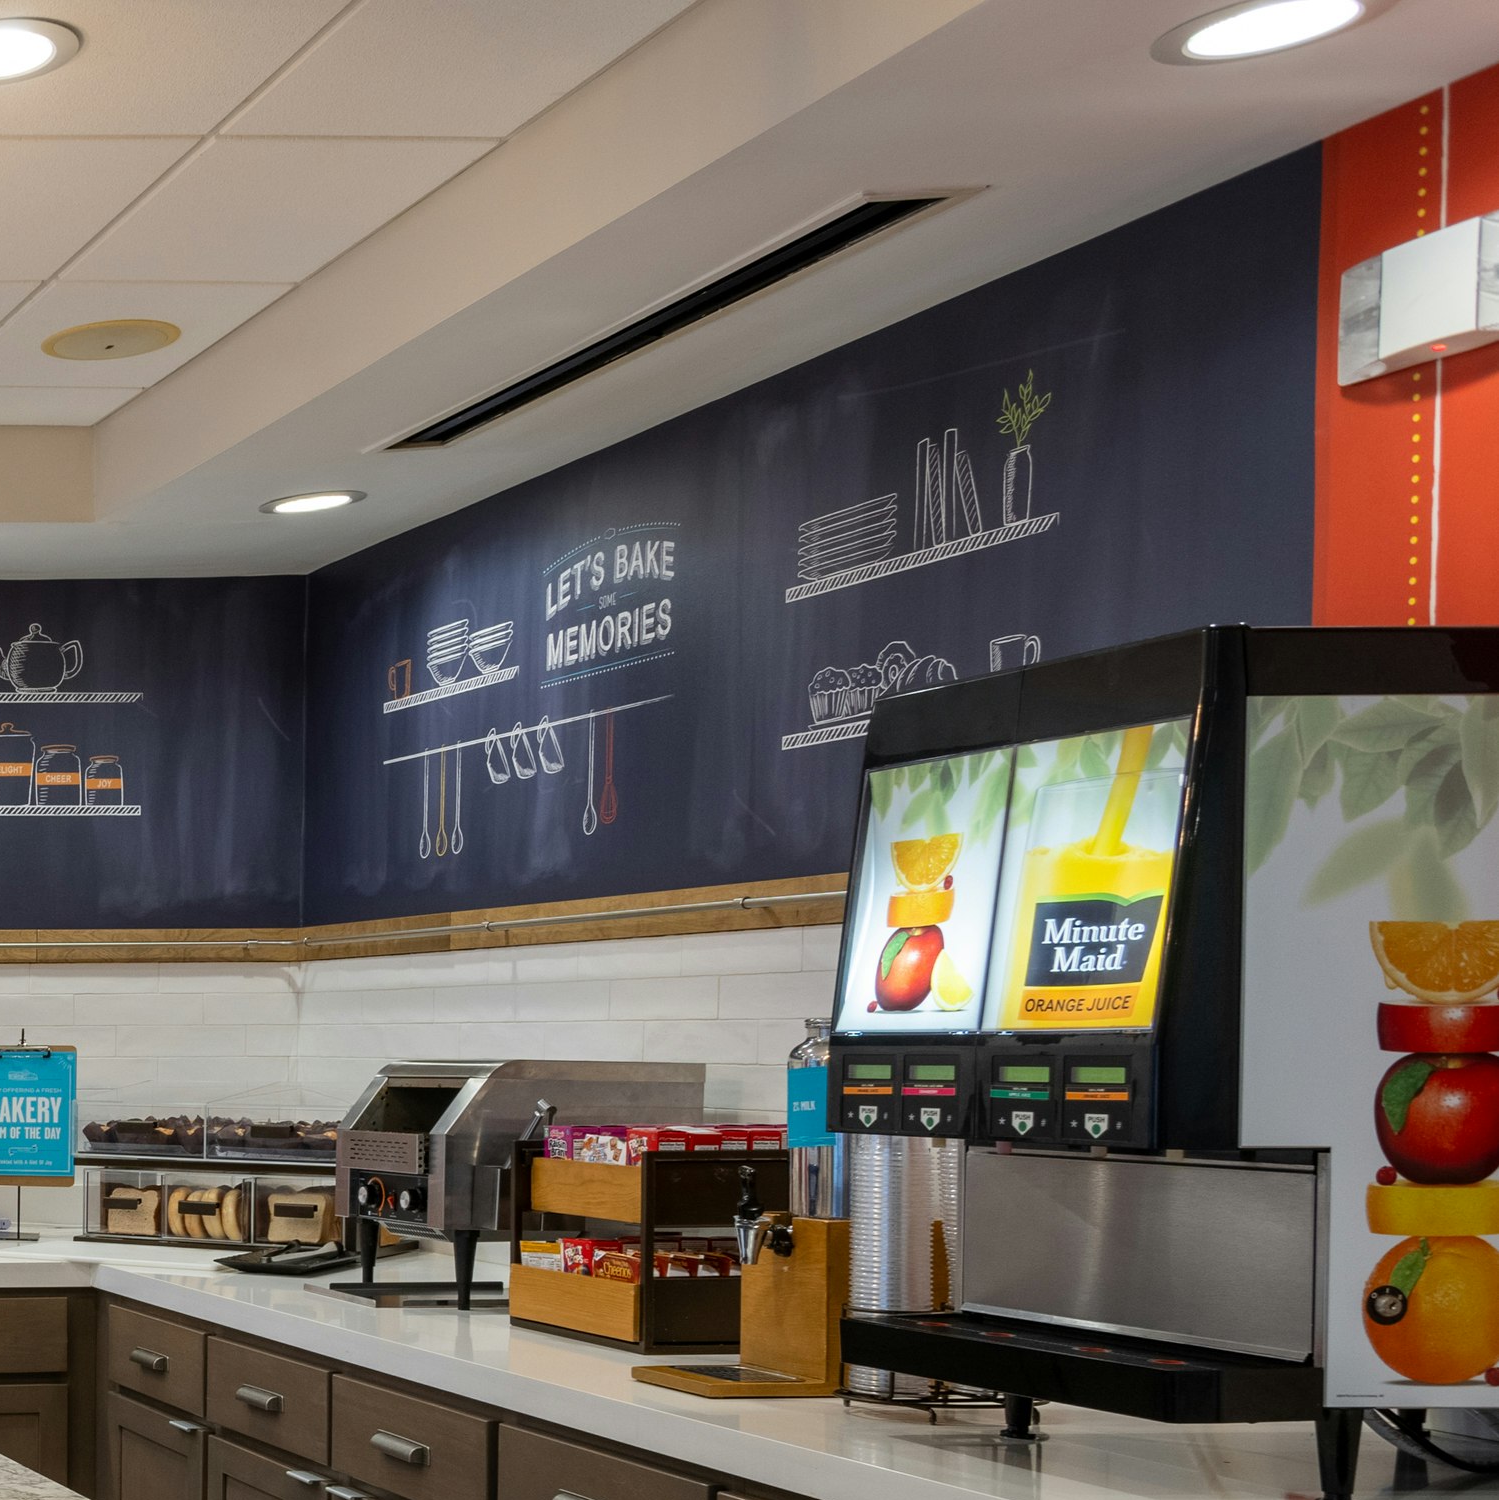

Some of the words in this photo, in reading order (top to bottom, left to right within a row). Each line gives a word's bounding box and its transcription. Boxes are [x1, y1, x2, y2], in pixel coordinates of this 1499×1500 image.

[546, 551, 605, 621] LET'S
[613, 540, 675, 584] BAKE
[598, 592, 617, 610] SOME
[545, 598, 672, 672] MEMORIES
[45, 775, 72, 783] CHEER
[96, 779, 112, 788] JOY
[1041, 918, 1146, 945] Minute
[1050, 944, 1126, 973] Maid
[1024, 998, 1086, 1013] ORANGE
[1086, 995, 1132, 1012] JUICE
[800, 1101, 816, 1111] MILK
[1014, 1113, 1031, 1121] PUSH
[9, 1126, 21, 1139] OF
[24, 1126, 41, 1139] THE
[44, 1127, 62, 1140] DAY
[603, 1262, 632, 1279] Cheerios
